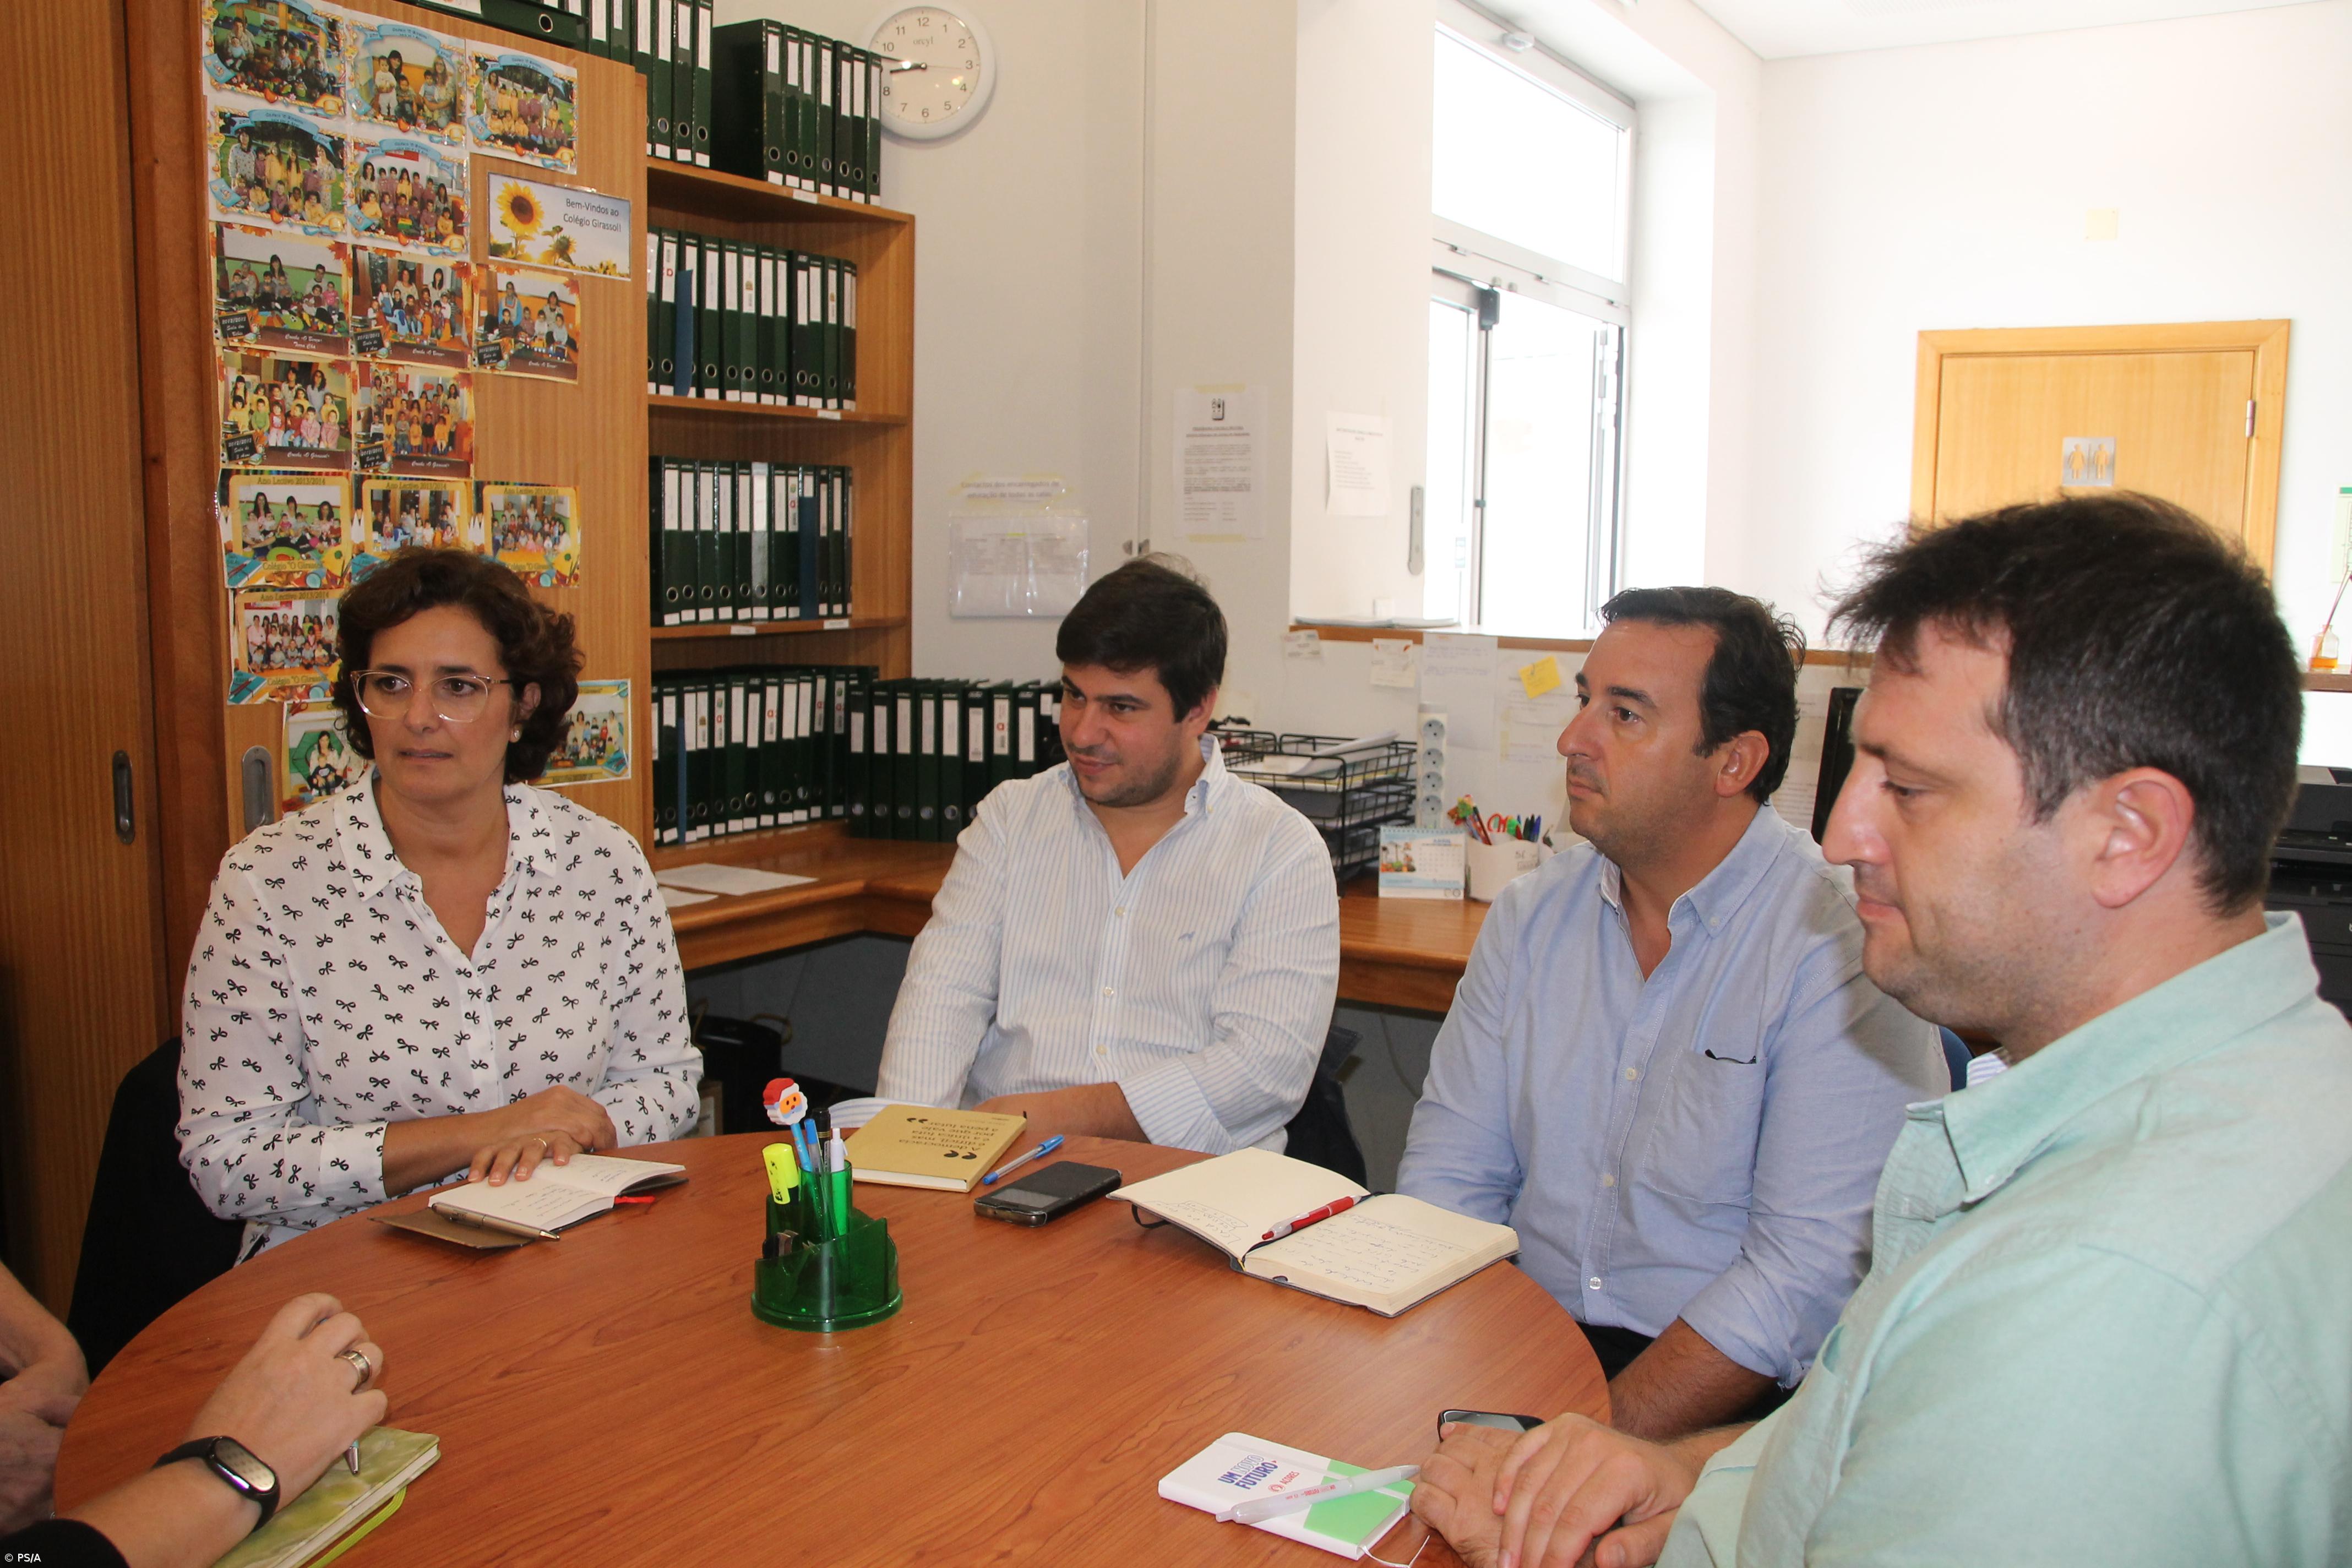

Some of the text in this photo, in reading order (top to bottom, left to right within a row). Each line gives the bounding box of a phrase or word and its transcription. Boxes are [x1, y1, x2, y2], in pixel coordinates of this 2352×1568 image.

[917, 17, 929, 27] 12
[896, 26, 906, 35] 11
[943, 24, 948, 33] 1
[883, 42, 894, 52] 10
[958, 39, 966, 48] 2
[966, 60, 973, 69] 3
[883, 86, 890, 96] 8
[960, 83, 967, 91] 4
[900, 102, 908, 112] 7
[944, 101, 951, 111] 5
[922, 108, 929, 118] 6
[566, 198, 608, 215] Bem-Vindos
[563, 214, 621, 232] Colégio Girassol!
[296, 477, 325, 485] 2013/2014
[899, 1139, 968, 1150] democracia
[1217, 1454, 1265, 1483] UM NOVO
[1234, 1462, 1278, 1490] FUTURO
[1280, 1471, 1300, 1485] AÇORES
